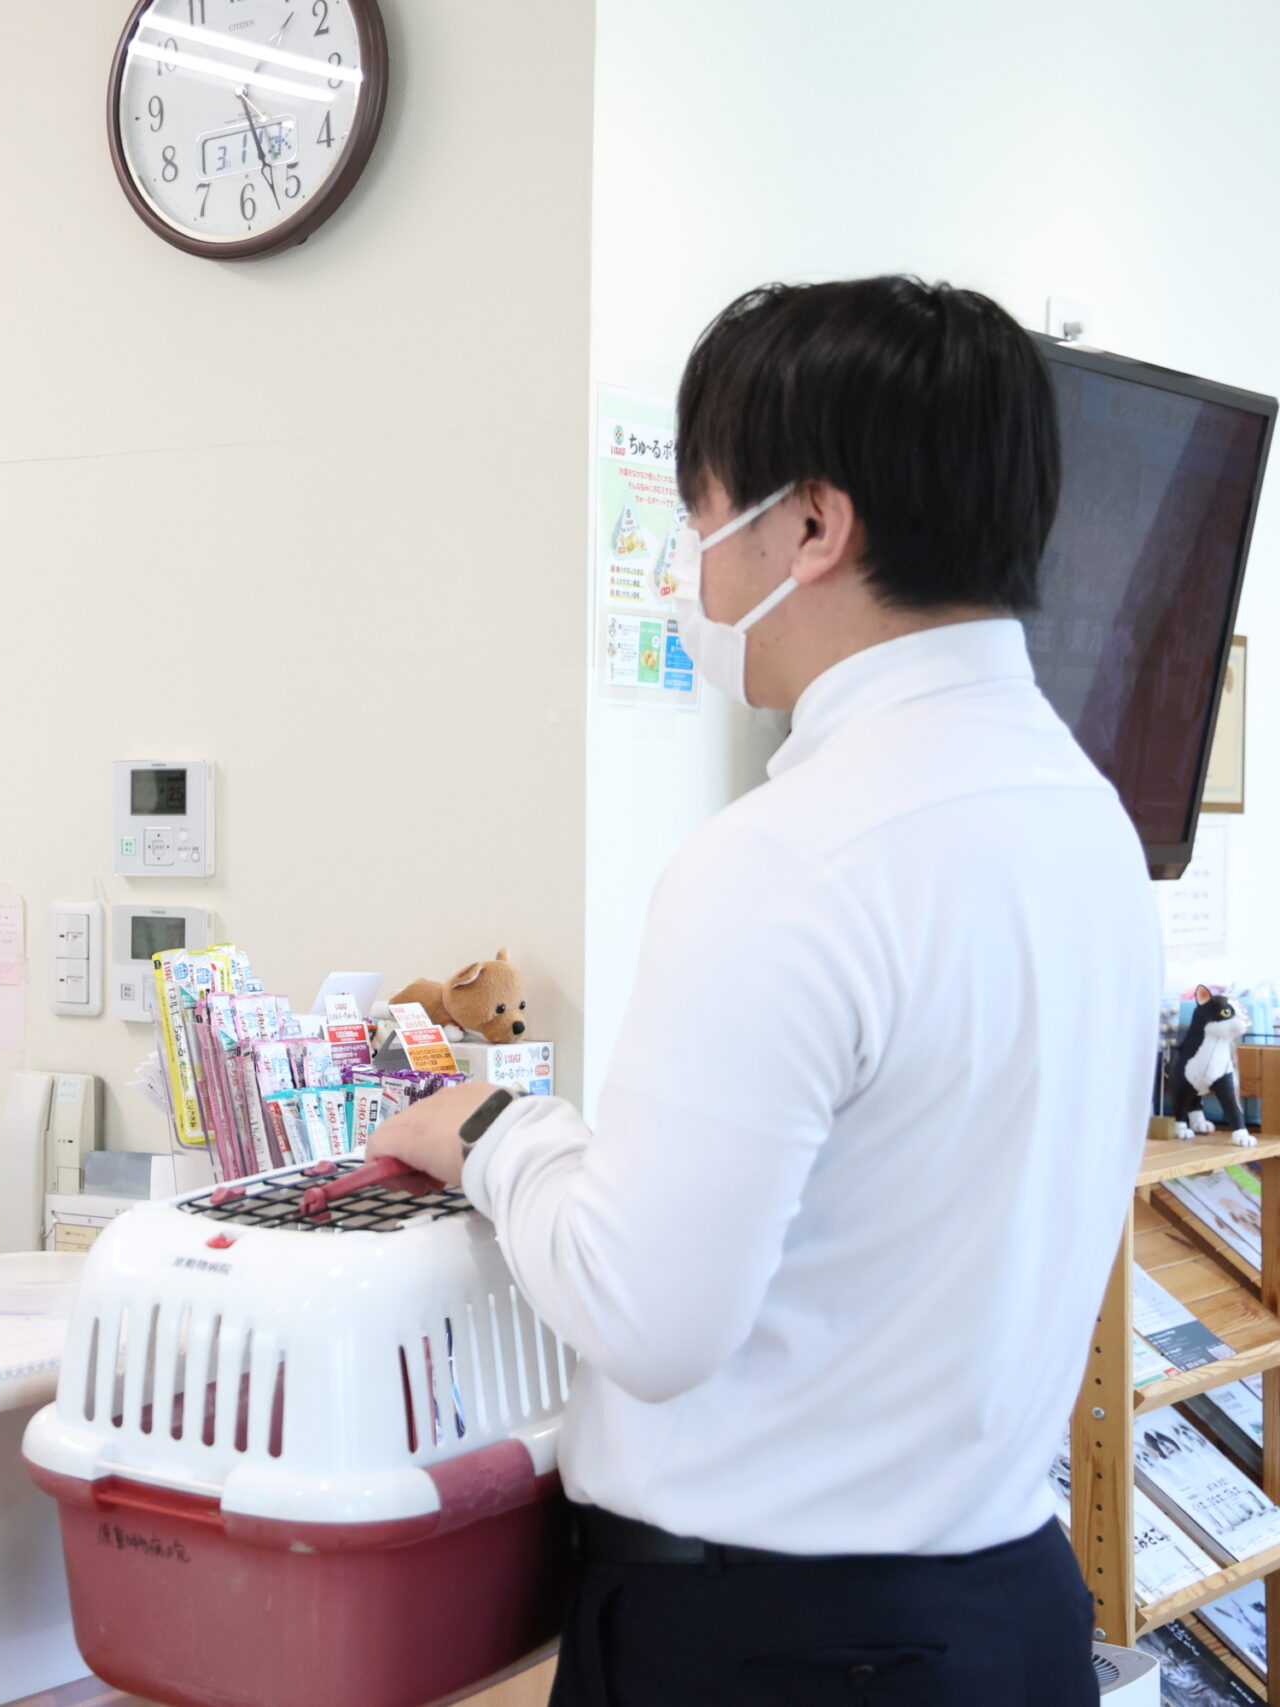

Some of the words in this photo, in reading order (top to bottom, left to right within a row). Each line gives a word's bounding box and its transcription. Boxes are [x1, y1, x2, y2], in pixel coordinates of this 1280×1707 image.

[228, 19, 255, 31] CITIZEN
[312, 0, 330, 37] 2
[147, 95, 164, 133] 9
[316, 110, 335, 149] 4
[161, 145, 179, 183] 8
[284, 161, 302, 199] 5
[195, 181, 212, 218] 7
[238, 183, 257, 221] 6
